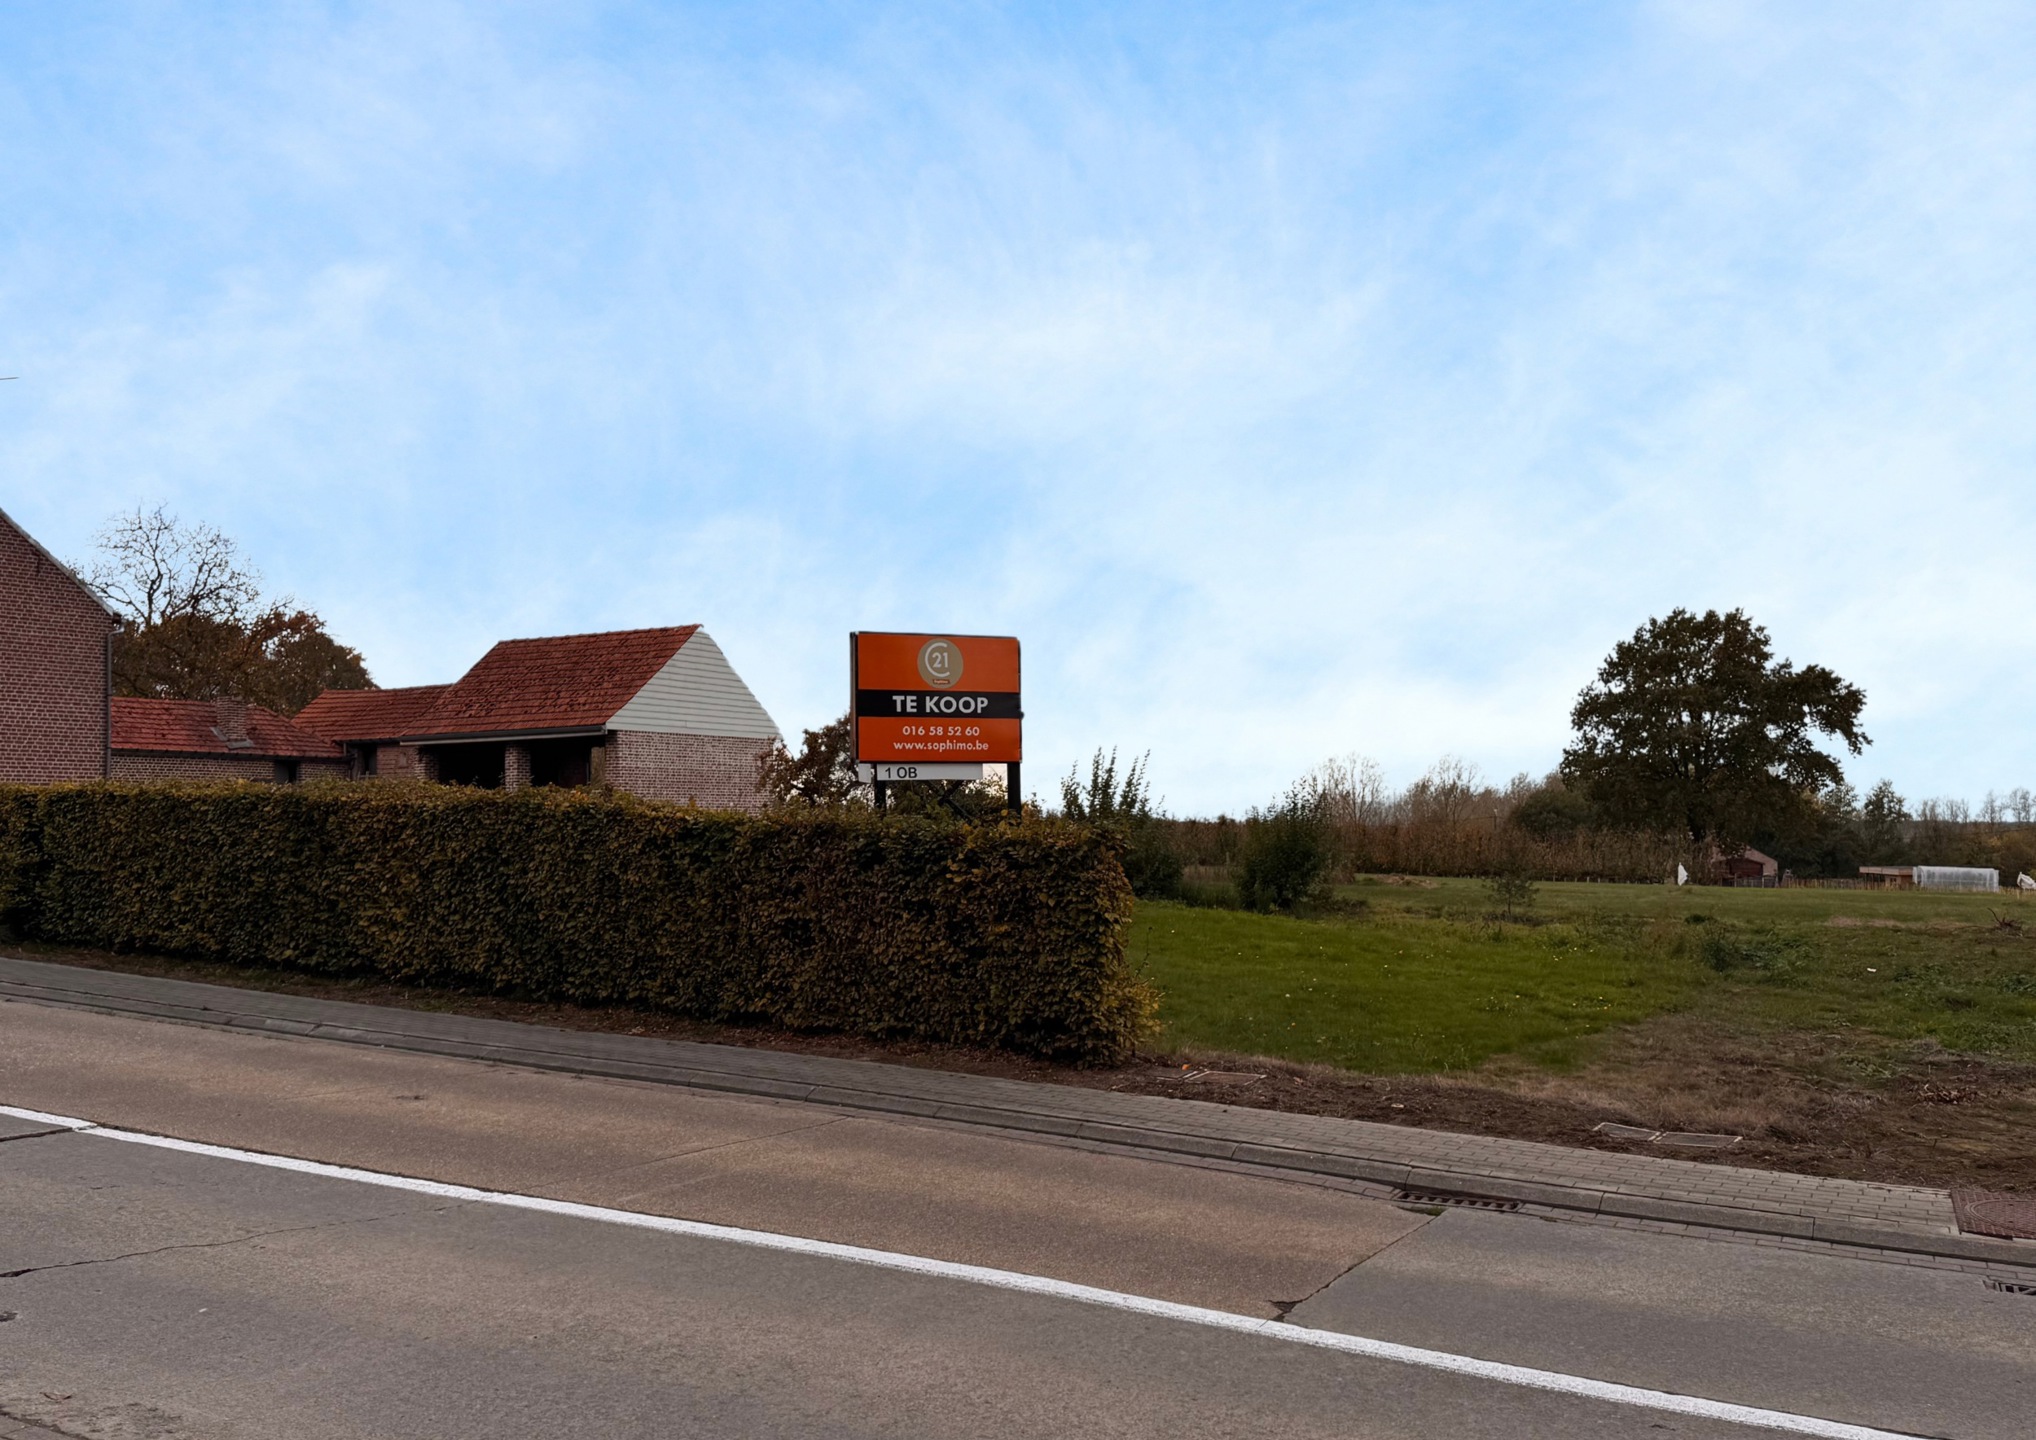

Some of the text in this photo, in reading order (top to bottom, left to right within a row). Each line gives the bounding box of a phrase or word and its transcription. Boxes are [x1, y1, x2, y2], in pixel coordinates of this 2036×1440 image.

[892, 695, 989, 714] TE KOOP
[902, 726, 980, 737] 016 58 52 60
[893, 740, 989, 752] www.sophimo.be
[885, 766, 918, 779] 1 OB
